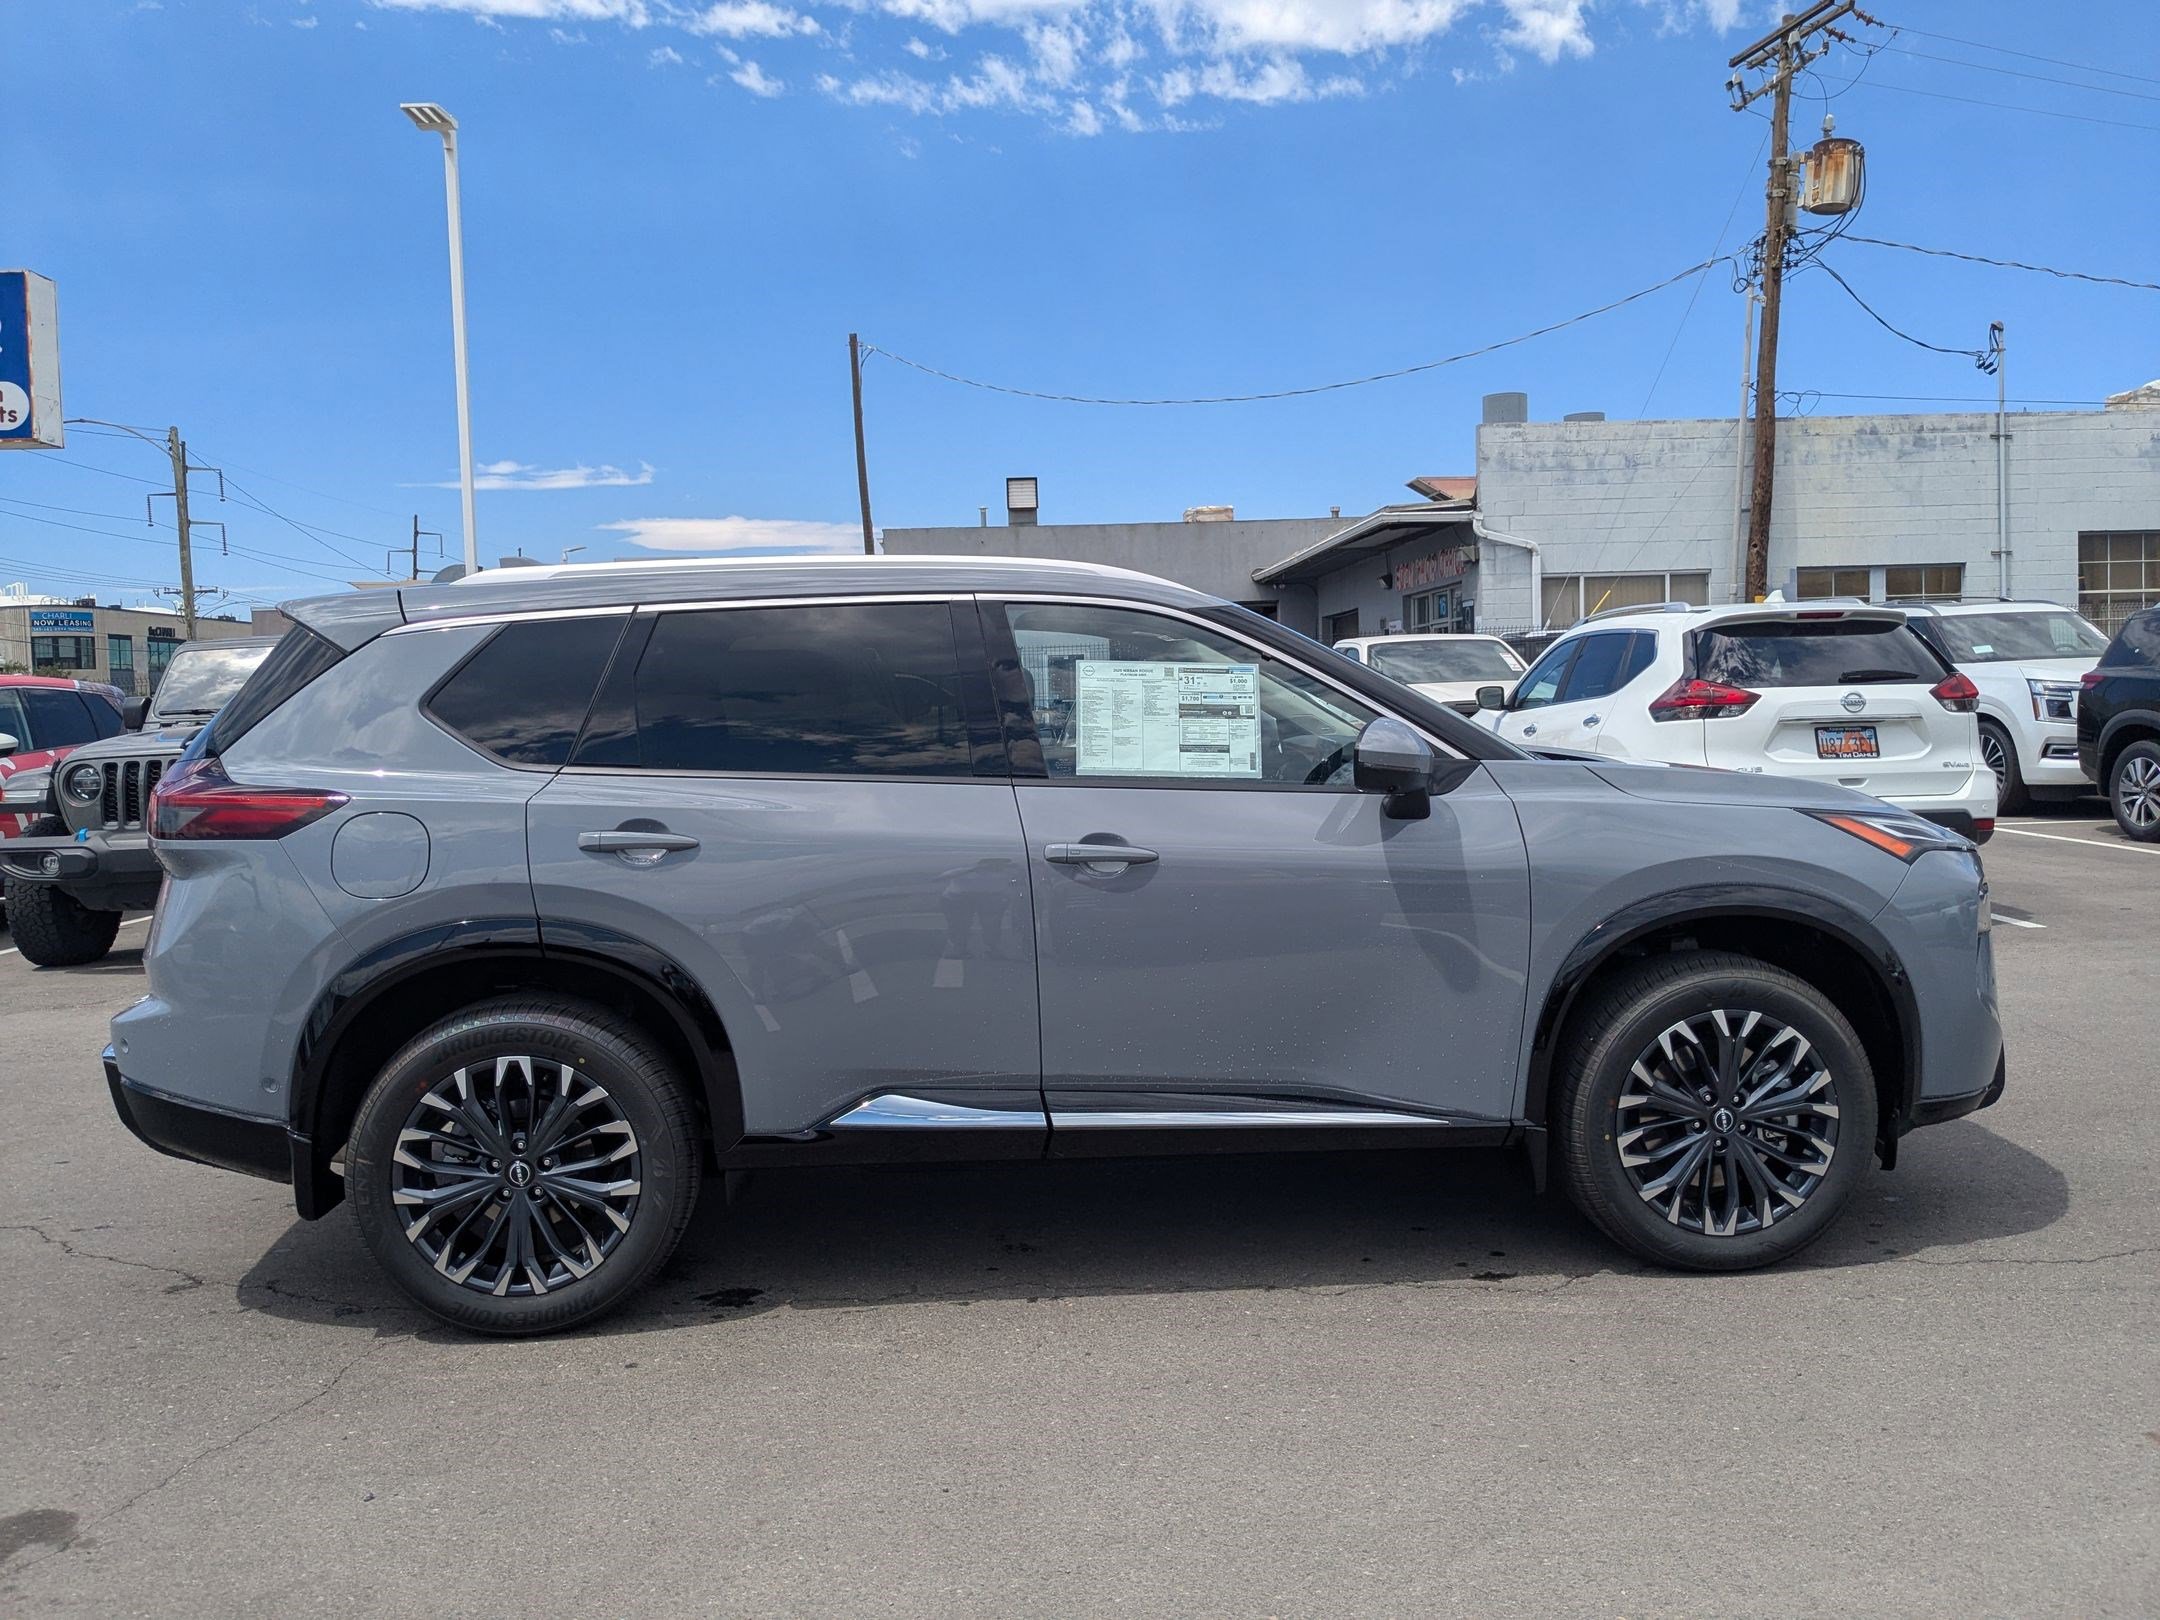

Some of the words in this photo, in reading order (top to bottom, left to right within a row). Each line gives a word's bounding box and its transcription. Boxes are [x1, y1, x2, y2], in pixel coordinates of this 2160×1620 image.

[41, 612, 73, 620] CHARLI
[58, 619, 93, 627] LEASING
[1184, 676, 1195, 685] 31
[433, 1027, 585, 1062] BRIDGESTONE
